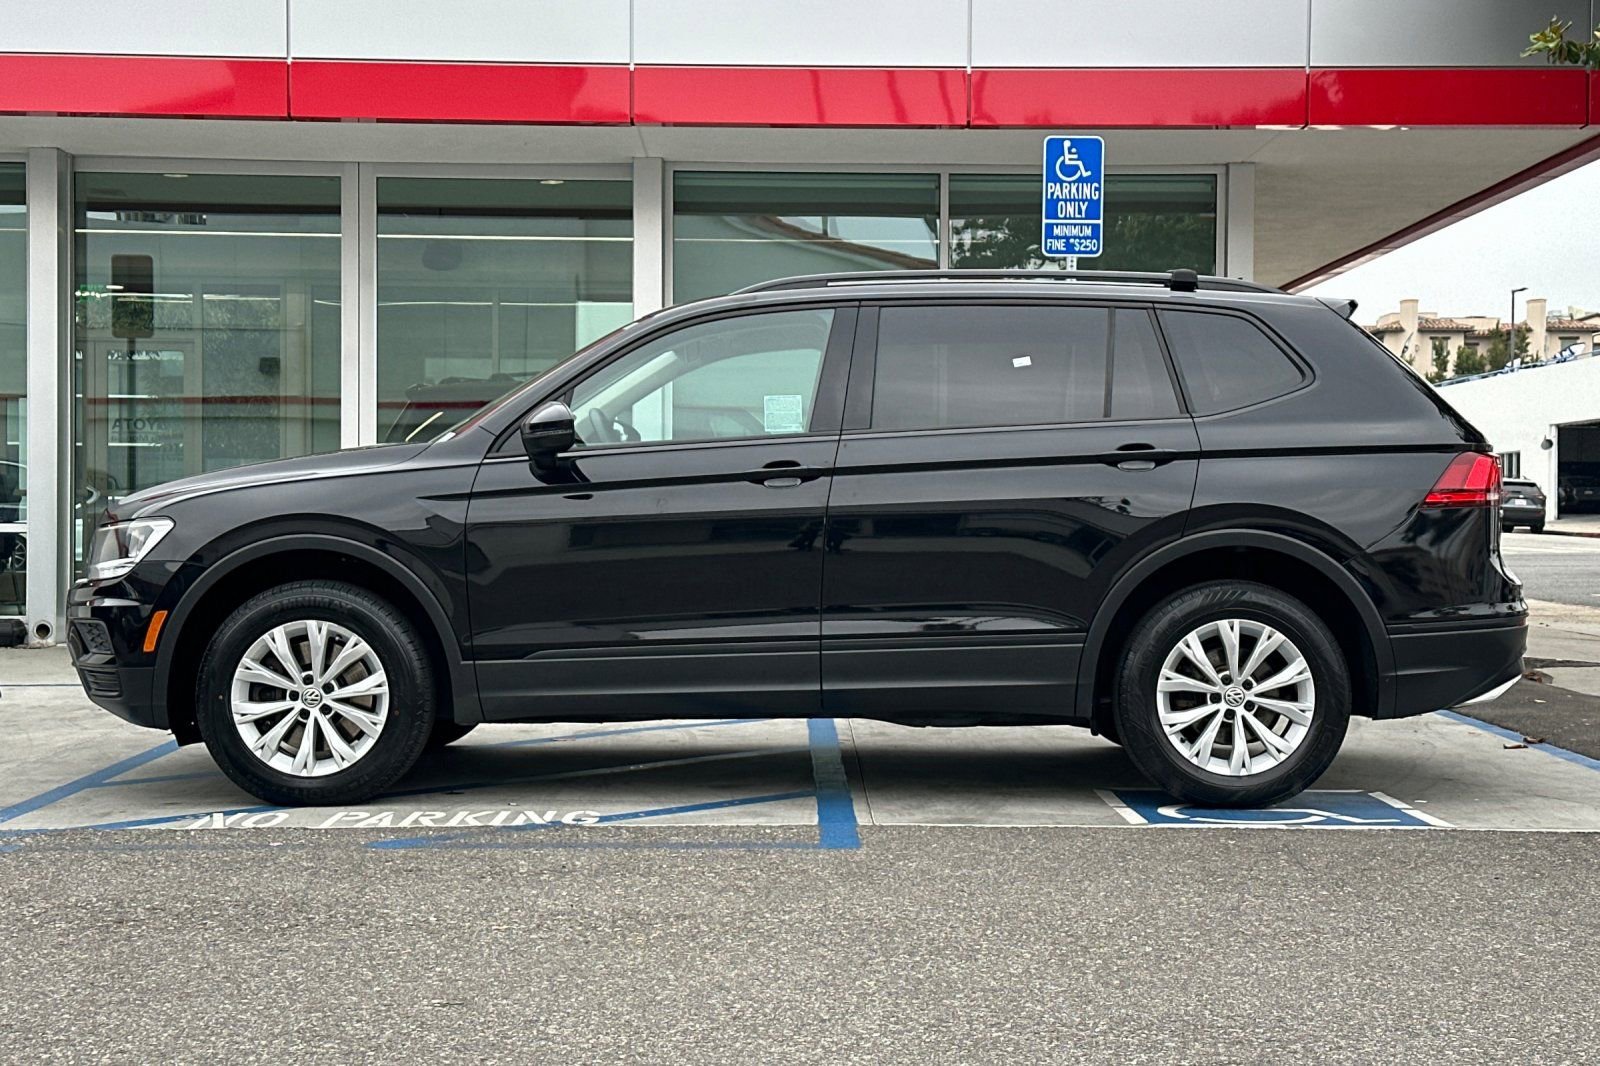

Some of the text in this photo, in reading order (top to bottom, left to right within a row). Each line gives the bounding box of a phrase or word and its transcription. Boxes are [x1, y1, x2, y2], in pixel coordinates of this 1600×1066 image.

[1047, 182, 1099, 200] PARKING
[1057, 201, 1088, 218] ONLY
[1053, 225, 1092, 237] MINIMUM
[1046, 239, 1098, 251] FINE $250
[186, 810, 601, 830] NO PARKING
